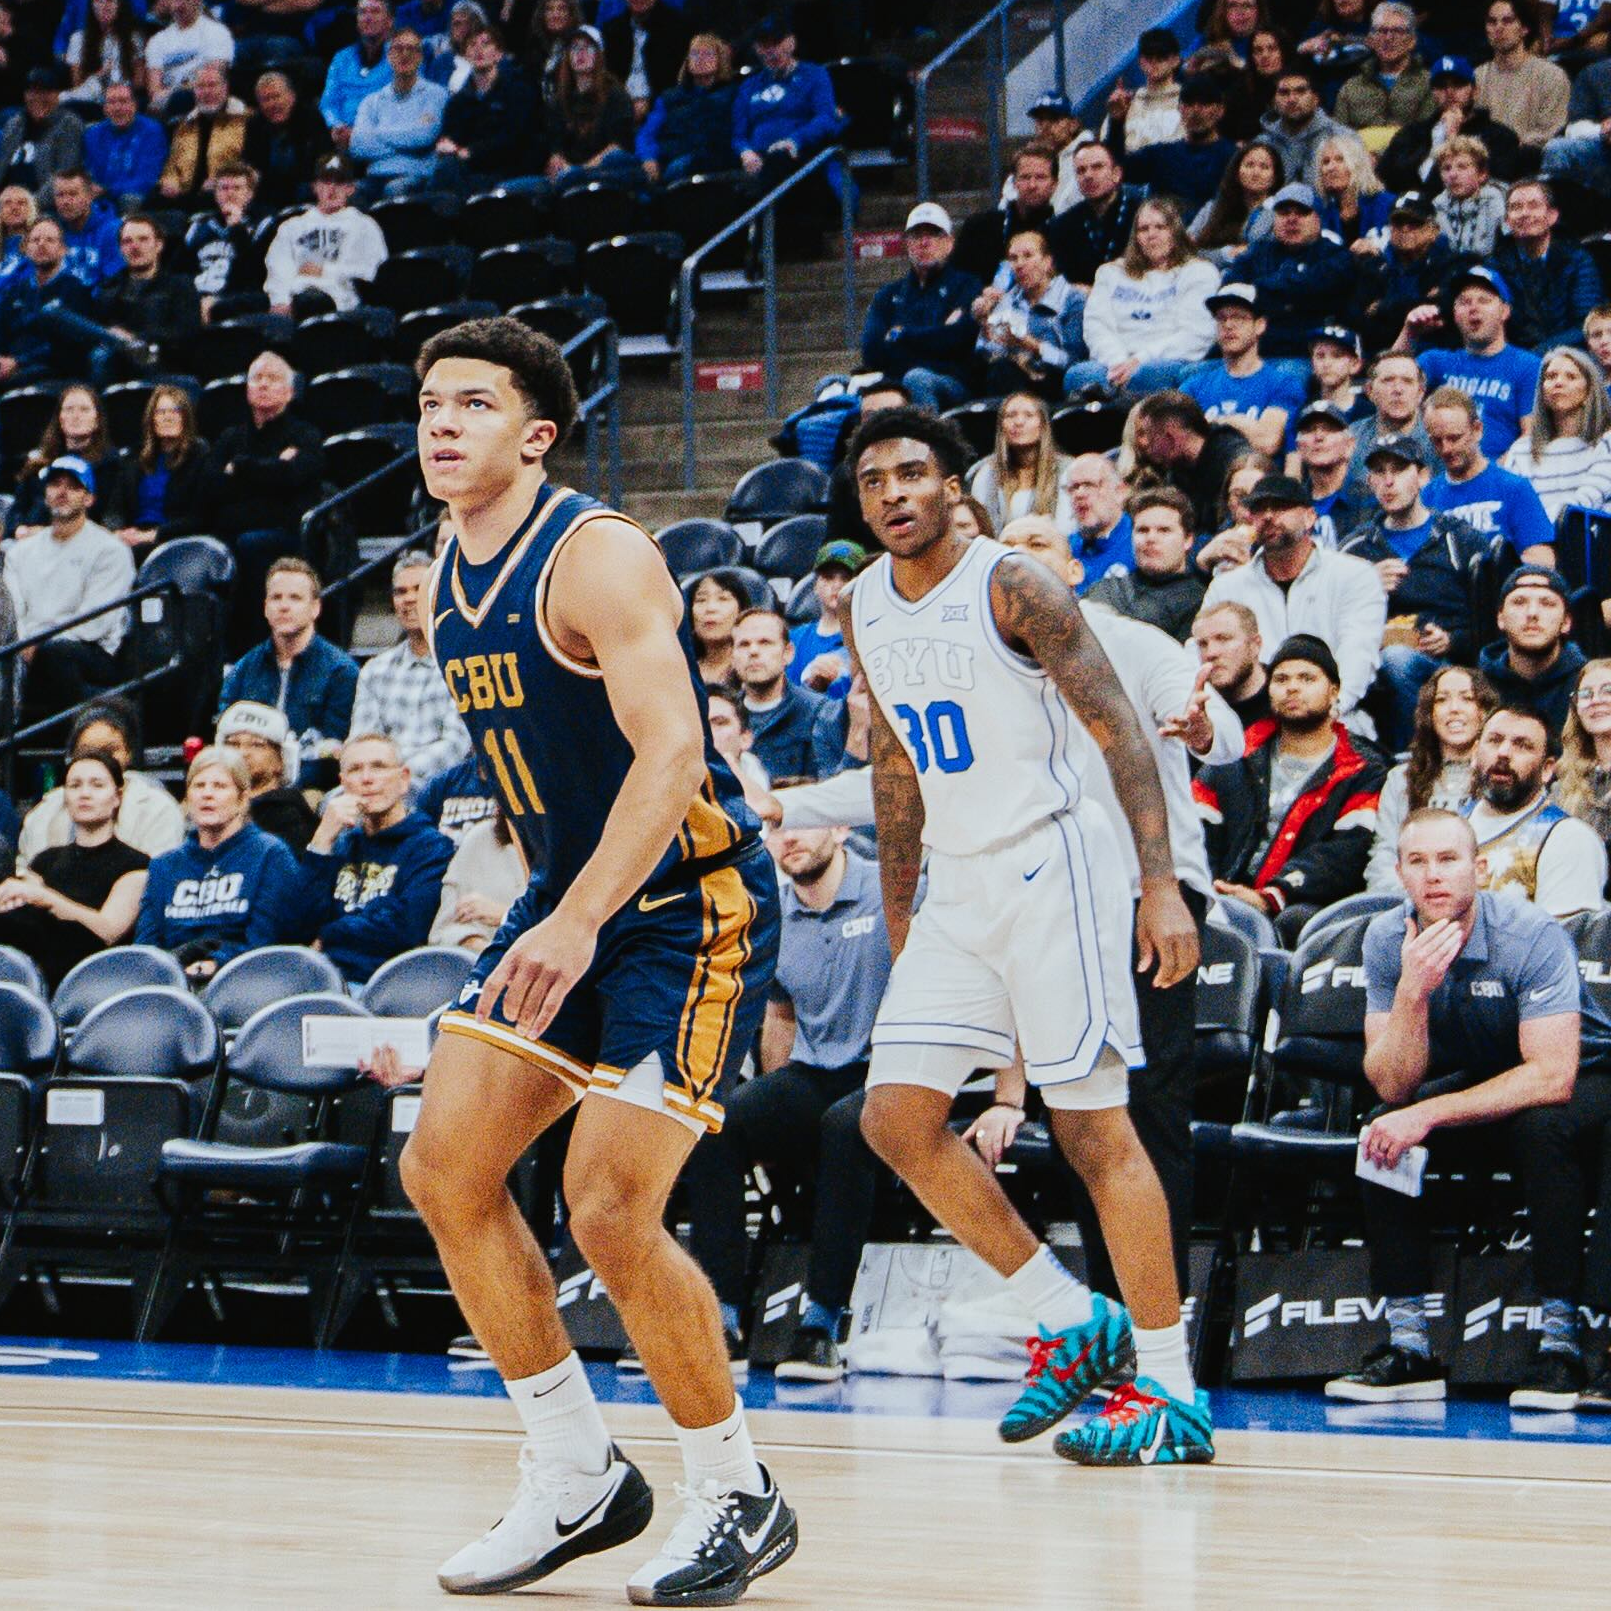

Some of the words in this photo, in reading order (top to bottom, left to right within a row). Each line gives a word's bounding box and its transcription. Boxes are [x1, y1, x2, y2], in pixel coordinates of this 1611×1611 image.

[444, 652, 525, 714] CBU
[866, 638, 975, 697] BYU
[892, 700, 975, 775] 30
[483, 728, 546, 815] 11
[172, 872, 244, 907] CBU
[842, 915, 876, 939] CBU
[1281, 1293, 1446, 1327] FILEVE
